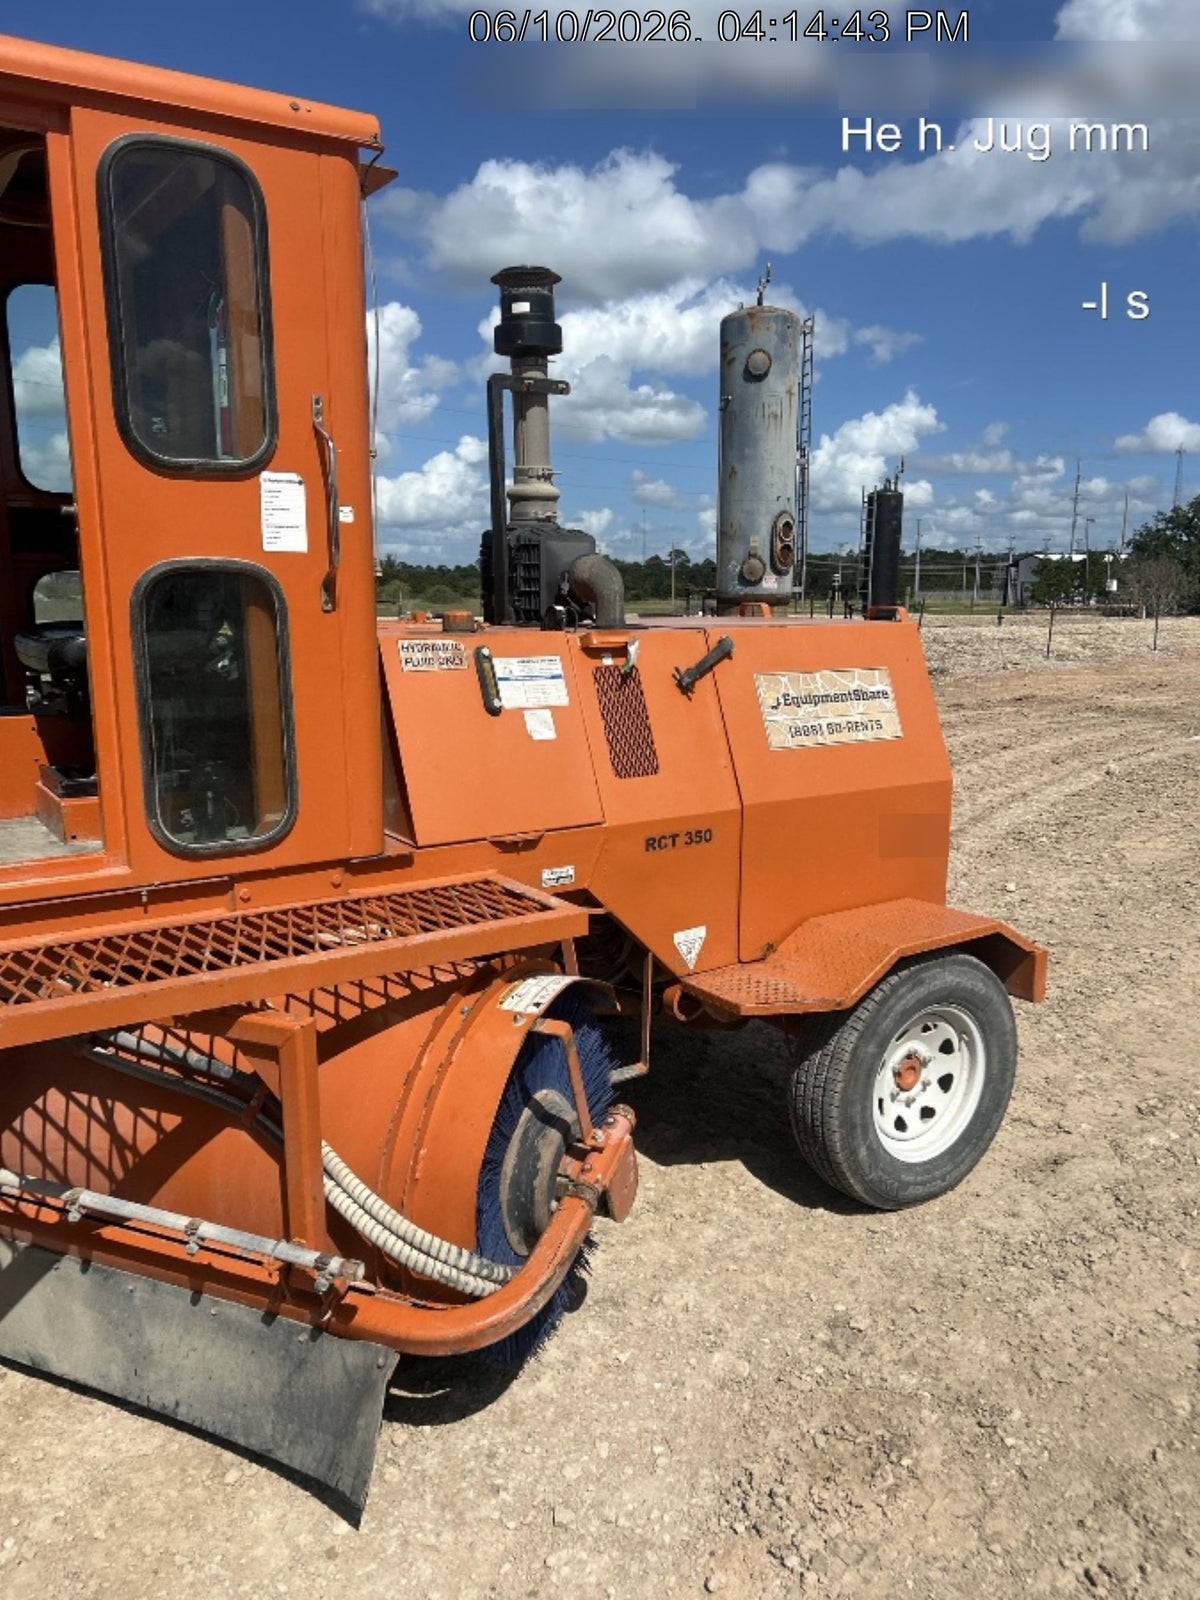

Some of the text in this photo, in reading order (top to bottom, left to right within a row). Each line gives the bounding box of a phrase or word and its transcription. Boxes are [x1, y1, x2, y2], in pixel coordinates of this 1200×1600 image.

[781, 688, 890, 709] EquipmentShare
[645, 828, 712, 852] RCT 350
